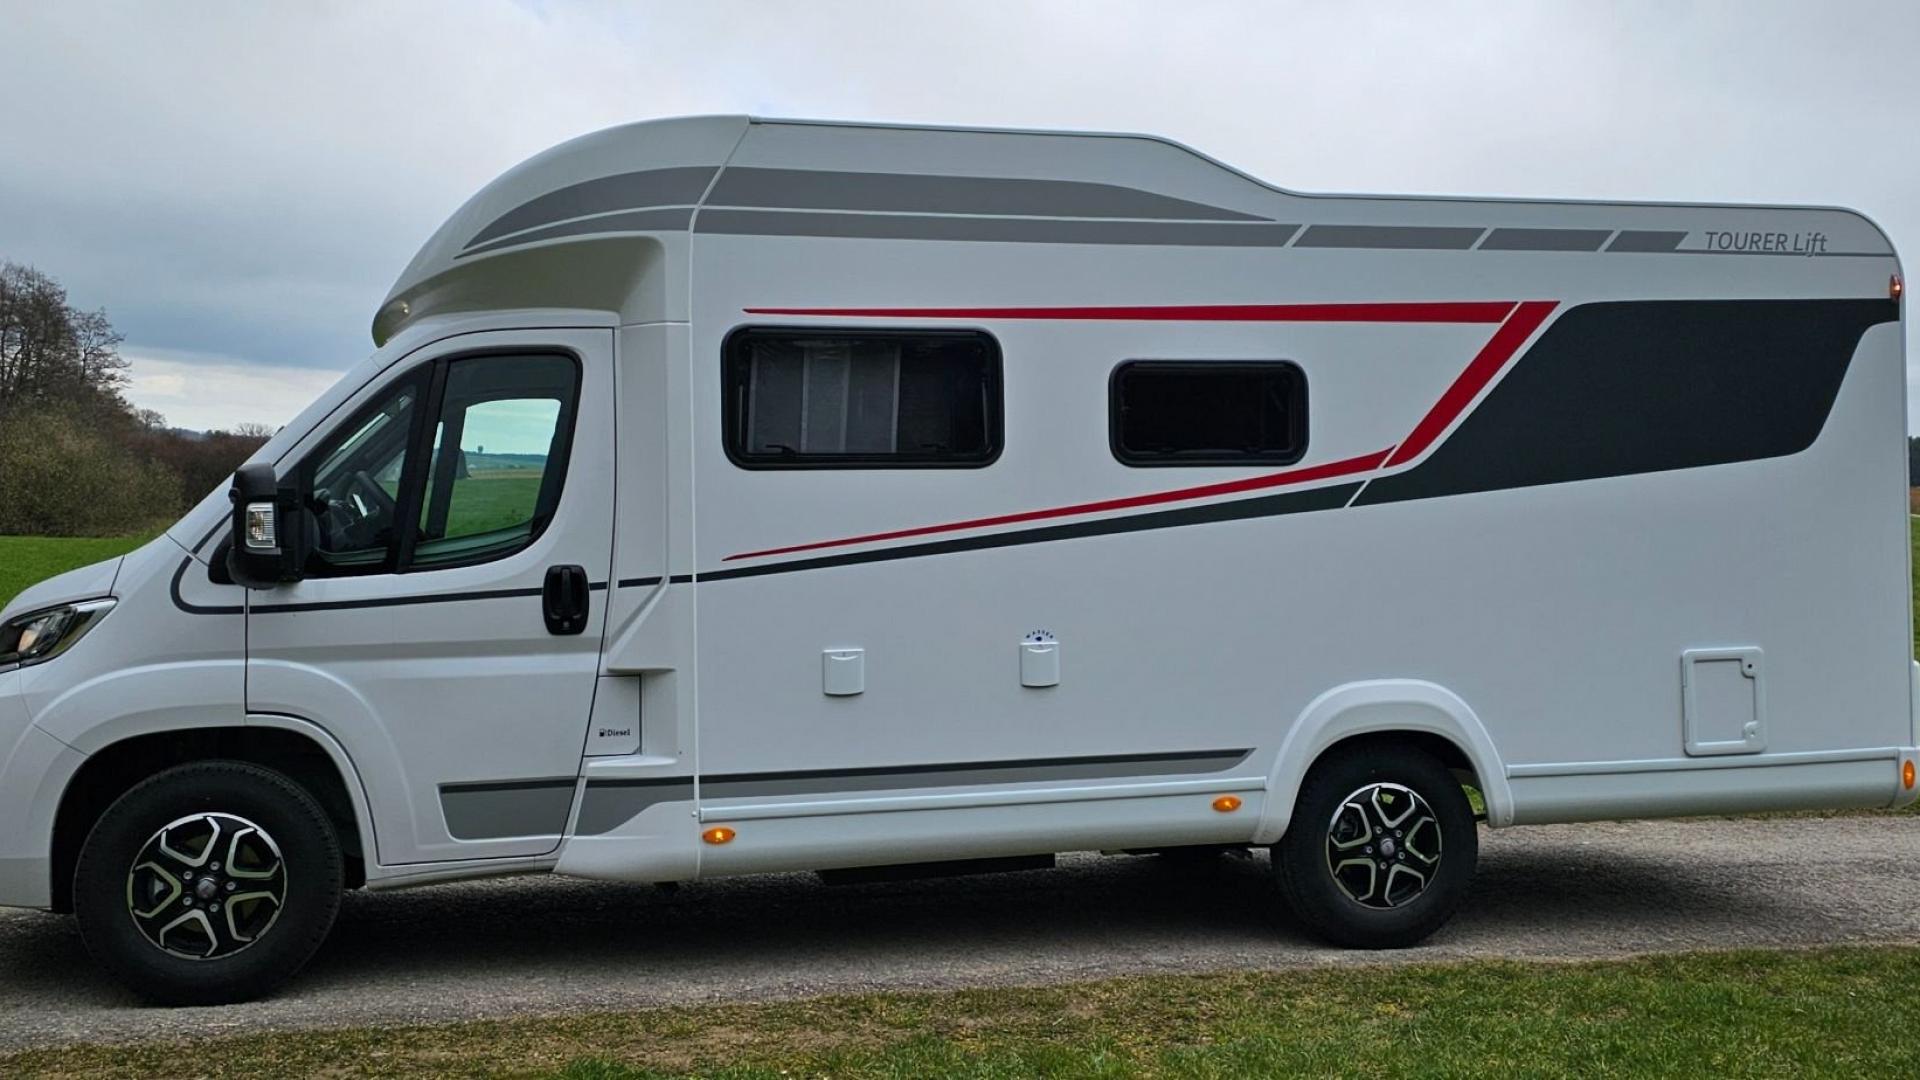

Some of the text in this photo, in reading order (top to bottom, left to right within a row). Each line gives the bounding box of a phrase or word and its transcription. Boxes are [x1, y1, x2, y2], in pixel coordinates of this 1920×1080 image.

[1705, 231, 1828, 258] TOURER Lift
[607, 728, 631, 737] Diesel
